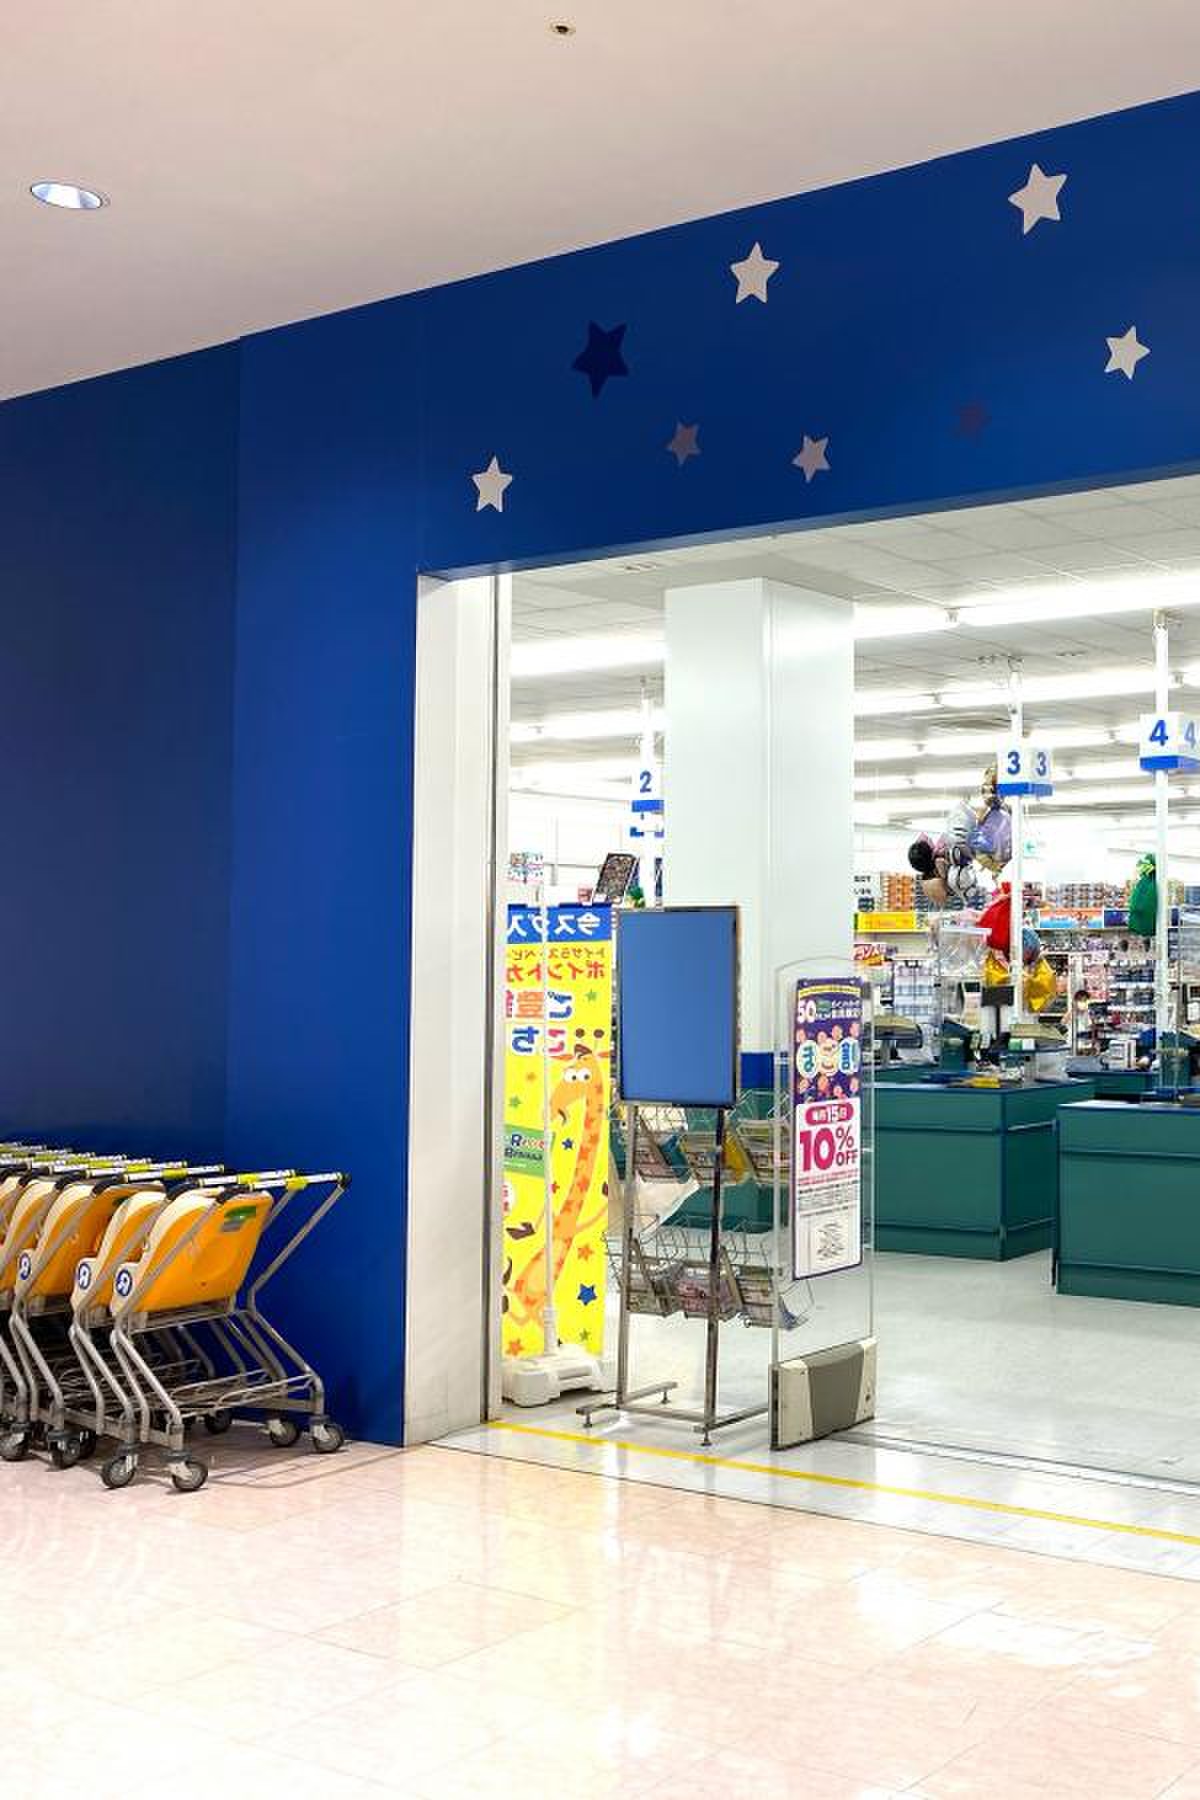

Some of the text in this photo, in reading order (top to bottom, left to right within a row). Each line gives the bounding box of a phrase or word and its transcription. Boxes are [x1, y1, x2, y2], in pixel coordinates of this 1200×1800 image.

[1150, 719, 1168, 746] 4
[1183, 721, 1196, 749] 4
[1007, 751, 1021, 775] 3
[1036, 752, 1047, 776] 3
[639, 770, 652, 793] 2
[836, 1150, 859, 1167] OFF
